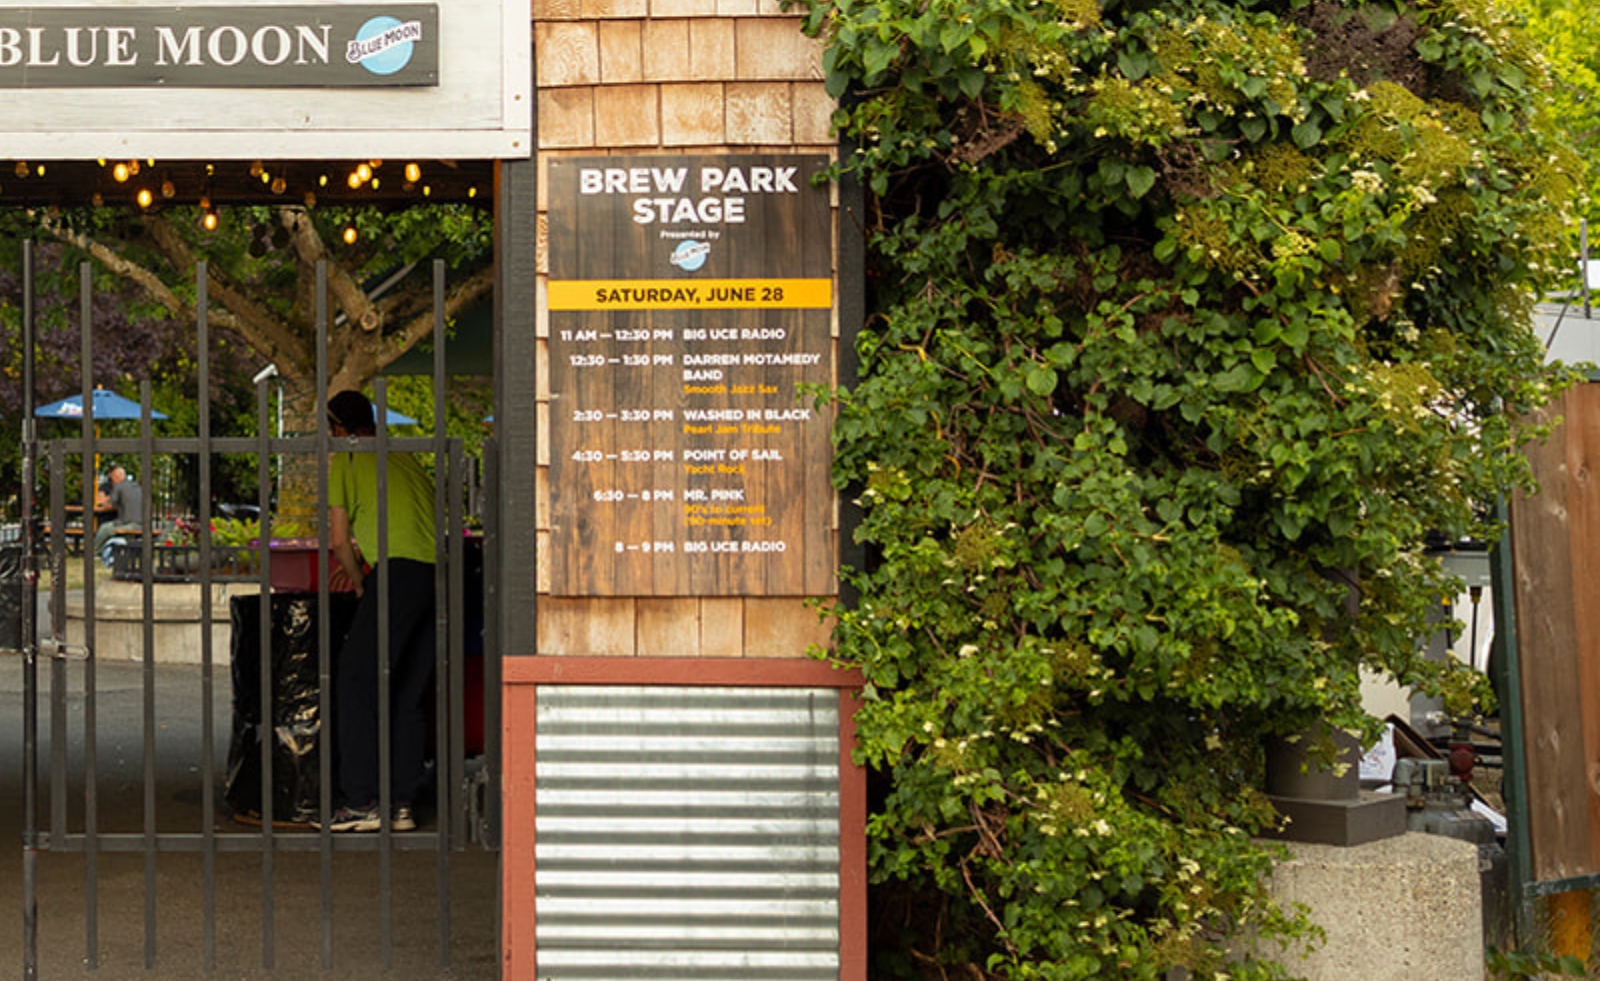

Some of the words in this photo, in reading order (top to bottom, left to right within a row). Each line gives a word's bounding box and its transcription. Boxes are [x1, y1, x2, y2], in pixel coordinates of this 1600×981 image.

[154, 24, 333, 66] MOON
[348, 36, 383, 61] BLUE
[384, 23, 419, 46] MOON
[580, 167, 688, 194] BREW
[700, 166, 799, 193] PARK
[632, 197, 746, 224] STAGE
[596, 288, 701, 305] SATURDAY,
[706, 288, 756, 303] JUNE
[762, 287, 785, 302] 28
[560, 330, 572, 342] 11
[575, 330, 597, 342] AM
[615, 329, 651, 341] 12:30
[653, 329, 673, 341] PM
[683, 328, 707, 340] BIG
[710, 328, 739, 340] UCE
[741, 328, 786, 340] RADIO
[570, 354, 606, 366] 12:30
[623, 354, 650, 366] 1:30
[653, 354, 673, 366] PM
[683, 354, 740, 366] DARREN
[743, 354, 820, 365] MOTAMEDY
[683, 370, 723, 381] BAND
[683, 384, 727, 395] Smooth
[573, 410, 603, 421] 2:30
[621, 410, 651, 421] 3:30
[653, 410, 674, 421] PM
[684, 409, 744, 421] WASHED
[746, 409, 761, 420] IN
[764, 409, 811, 420] BLACK
[683, 424, 713, 434] Pearl
[715, 424, 739, 435] Jam
[742, 424, 781, 434] Tribute
[571, 450, 603, 462] 4:30
[621, 450, 651, 462] 5:30
[653, 450, 674, 461] PM
[684, 449, 726, 461] POINT
[729, 449, 749, 461] OF
[752, 449, 783, 460] SAIL
[717, 464, 746, 475] Rock
[593, 490, 624, 501] 6:30
[642, 490, 651, 501] 8
[653, 490, 674, 501] PM
[684, 489, 709, 501] MR.
[711, 489, 745, 501] PINK
[710, 505, 722, 514] to
[615, 541, 624, 553] 8
[642, 541, 651, 553] 9
[653, 541, 674, 553] PM
[684, 541, 708, 552] BIG
[710, 541, 739, 552] UCE
[741, 541, 787, 552] RADIO
